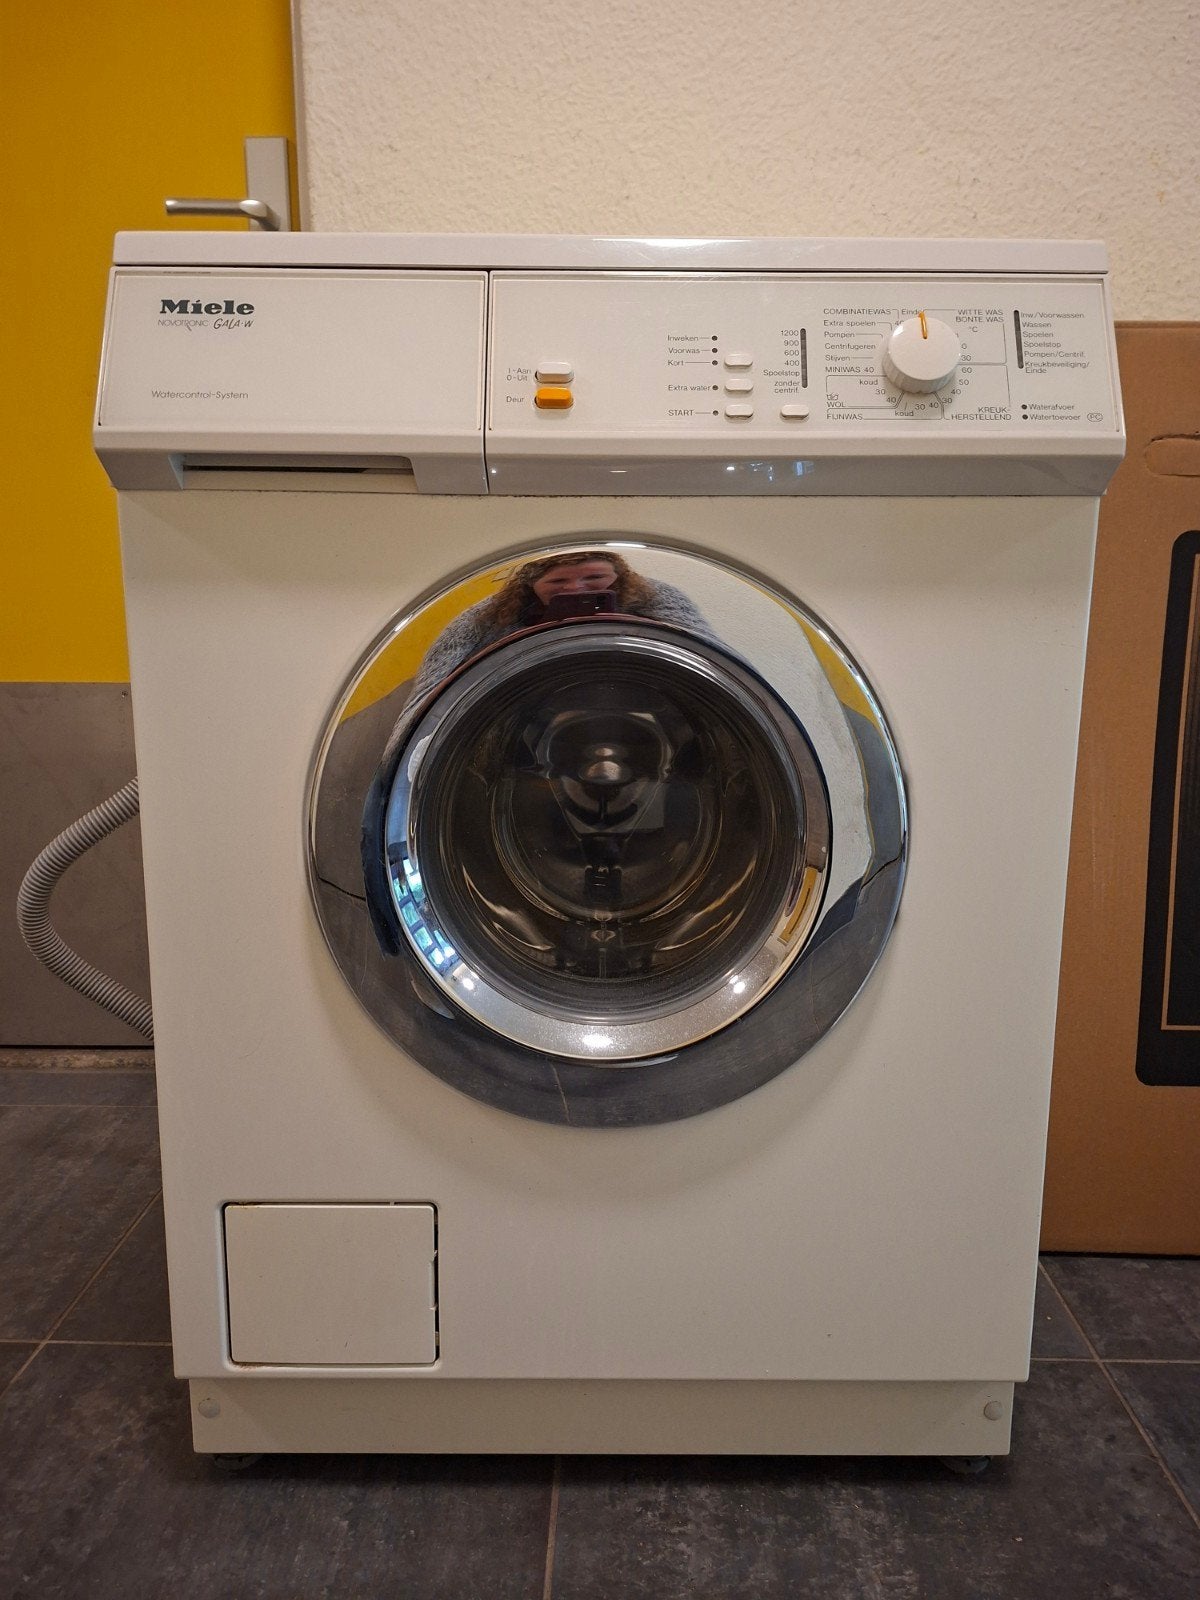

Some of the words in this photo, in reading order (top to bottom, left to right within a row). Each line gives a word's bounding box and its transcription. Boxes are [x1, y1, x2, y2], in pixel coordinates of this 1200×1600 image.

[160, 299, 255, 315] Miele
[157, 319, 209, 332] NOVOTRONIC
[152, 390, 249, 400] Watercontrol-System
